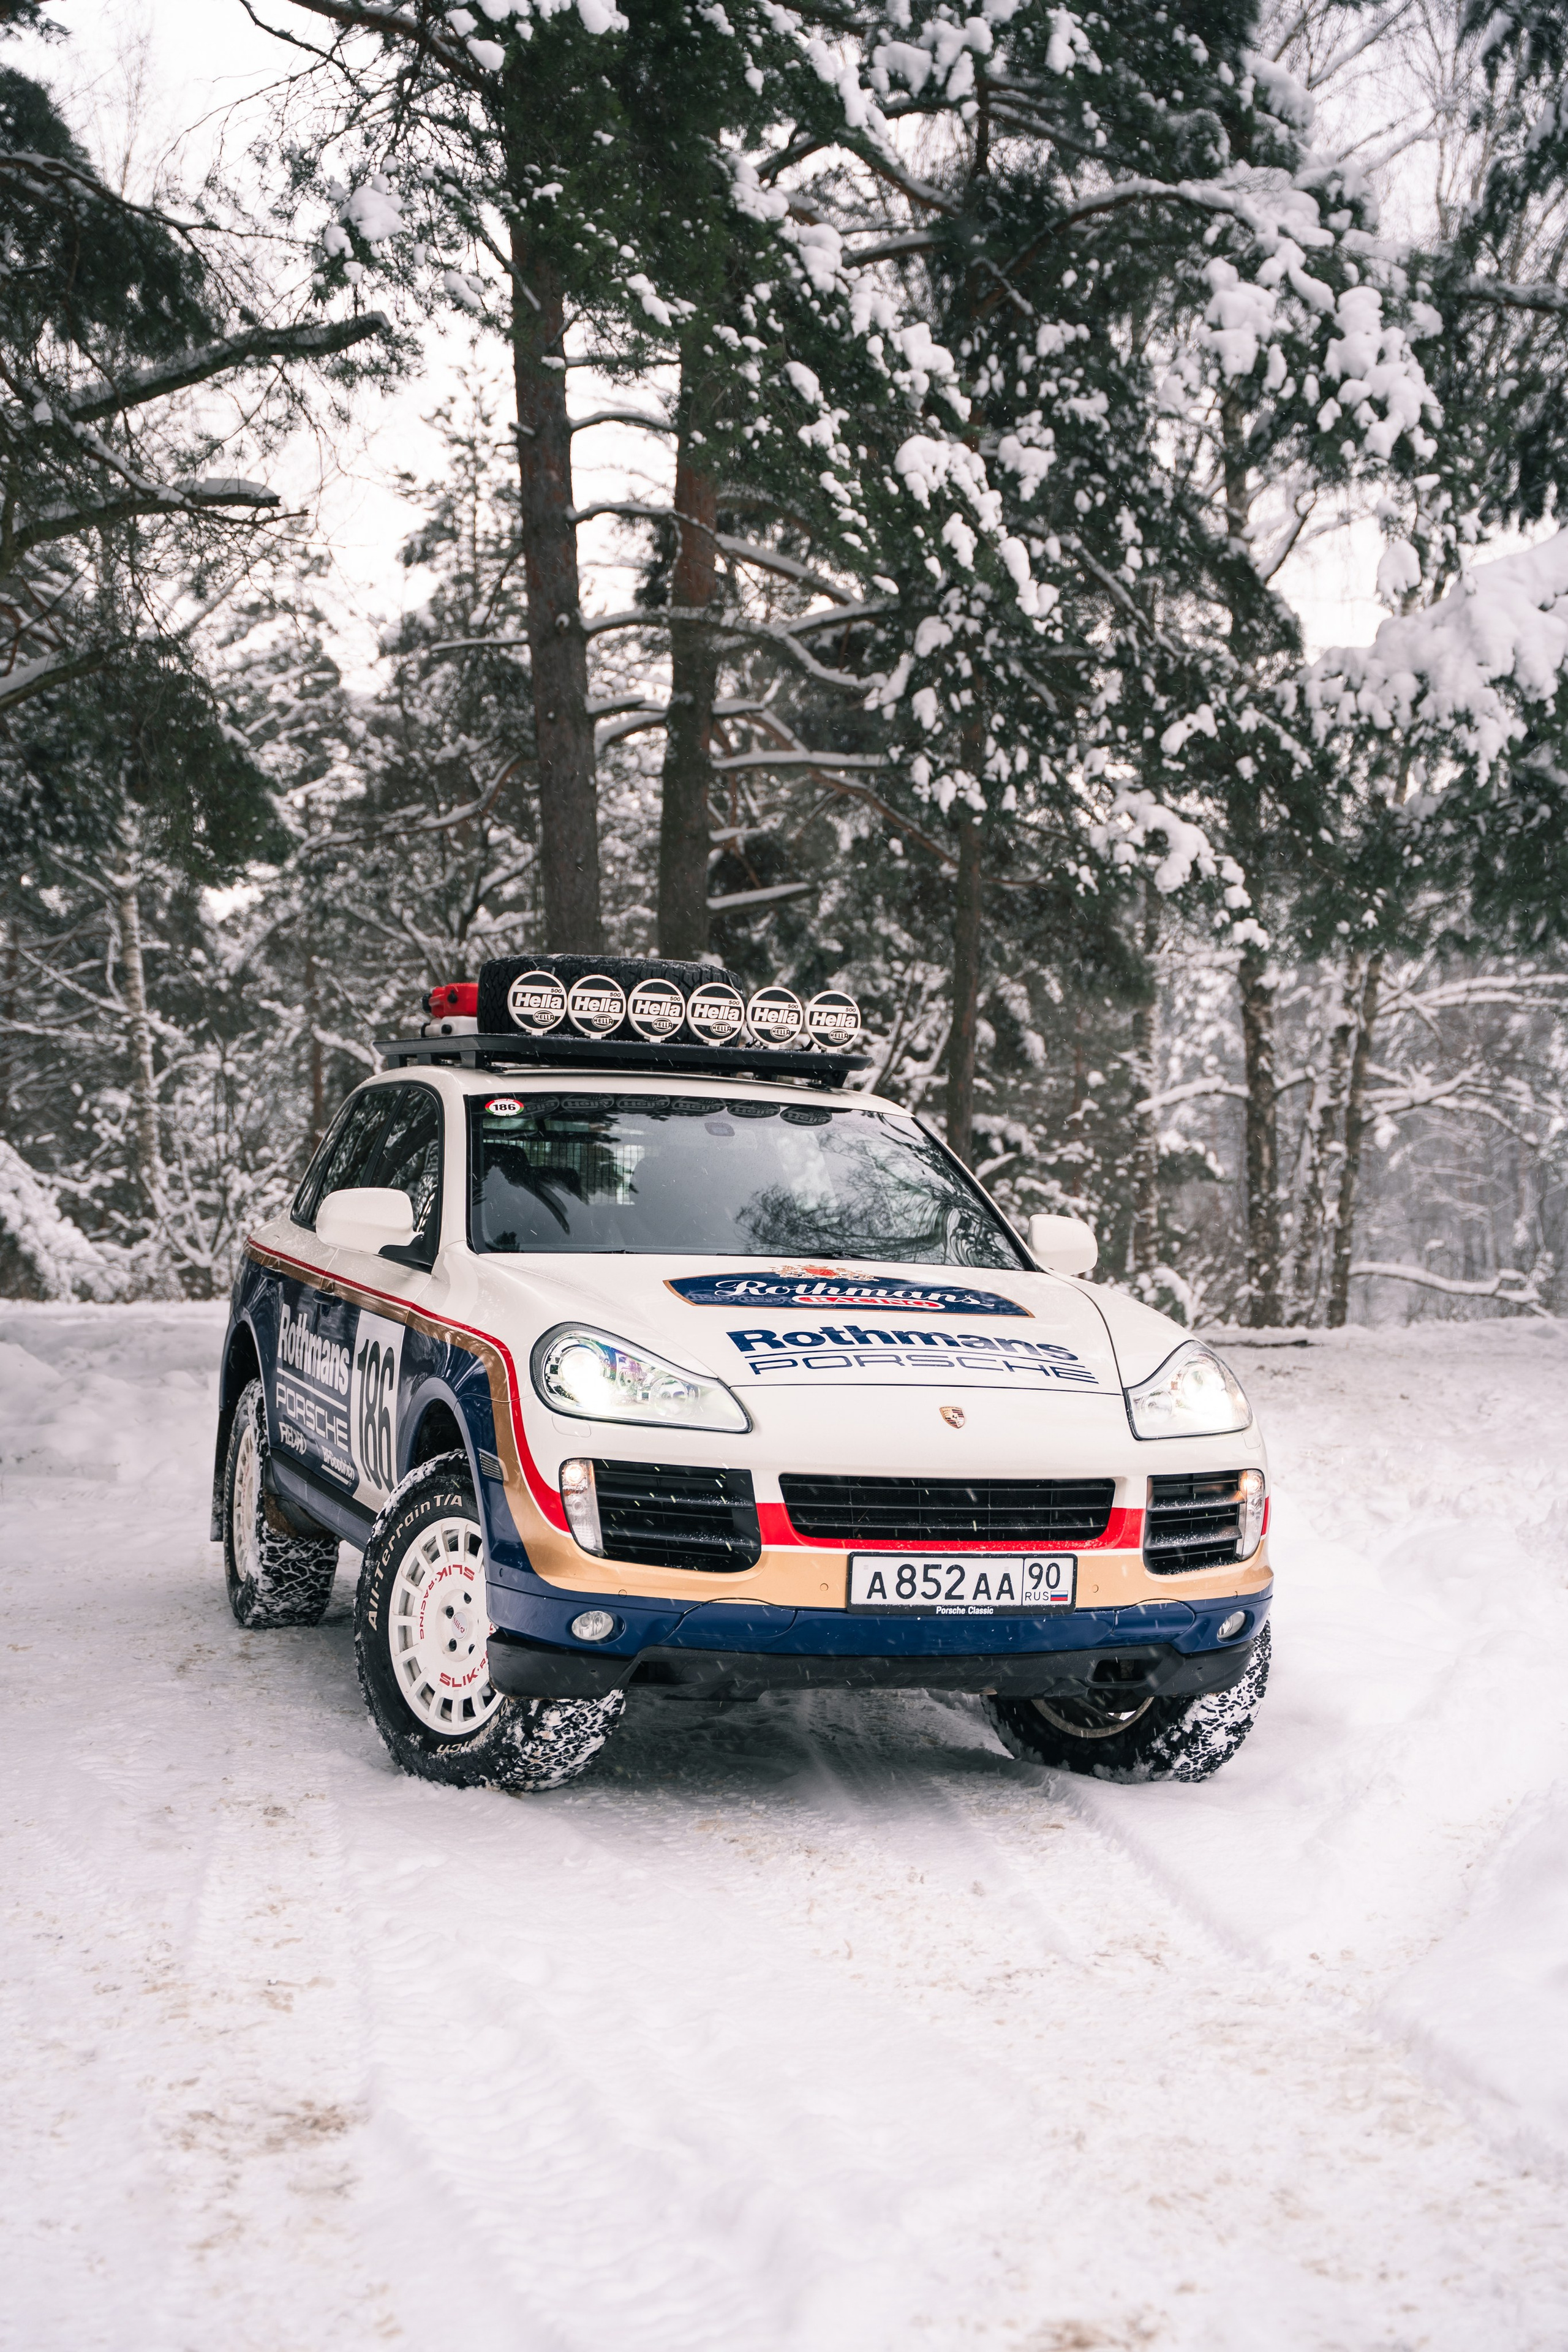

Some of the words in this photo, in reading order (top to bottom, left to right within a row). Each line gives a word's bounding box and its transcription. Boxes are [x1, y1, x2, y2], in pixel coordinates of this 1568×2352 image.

[515, 992, 562, 1009] Hella
[574, 996, 621, 1013] Hella
[635, 1000, 681, 1017] Hella
[693, 1004, 740, 1020] Hella
[753, 1008, 799, 1025] Hella
[812, 1012, 857, 1028] Hella
[714, 1280, 995, 1306] Rothmans
[807, 1297, 932, 1307] RACING
[277, 1303, 350, 1396] Rothmans
[726, 1325, 1078, 1361] Rothmans
[748, 1354, 1099, 1384] PORSCHE
[276, 1382, 349, 1452] PORSCHE
[357, 1339, 394, 1495] 186
[434, 1494, 462, 1507] T/A
[437, 1564, 475, 1582] SLIK
[1028, 1562, 1060, 1589] 90
[1025, 1592, 1049, 1601] RUS
[968, 1606, 994, 1615] Classic
[439, 1667, 478, 1687] SLIK
